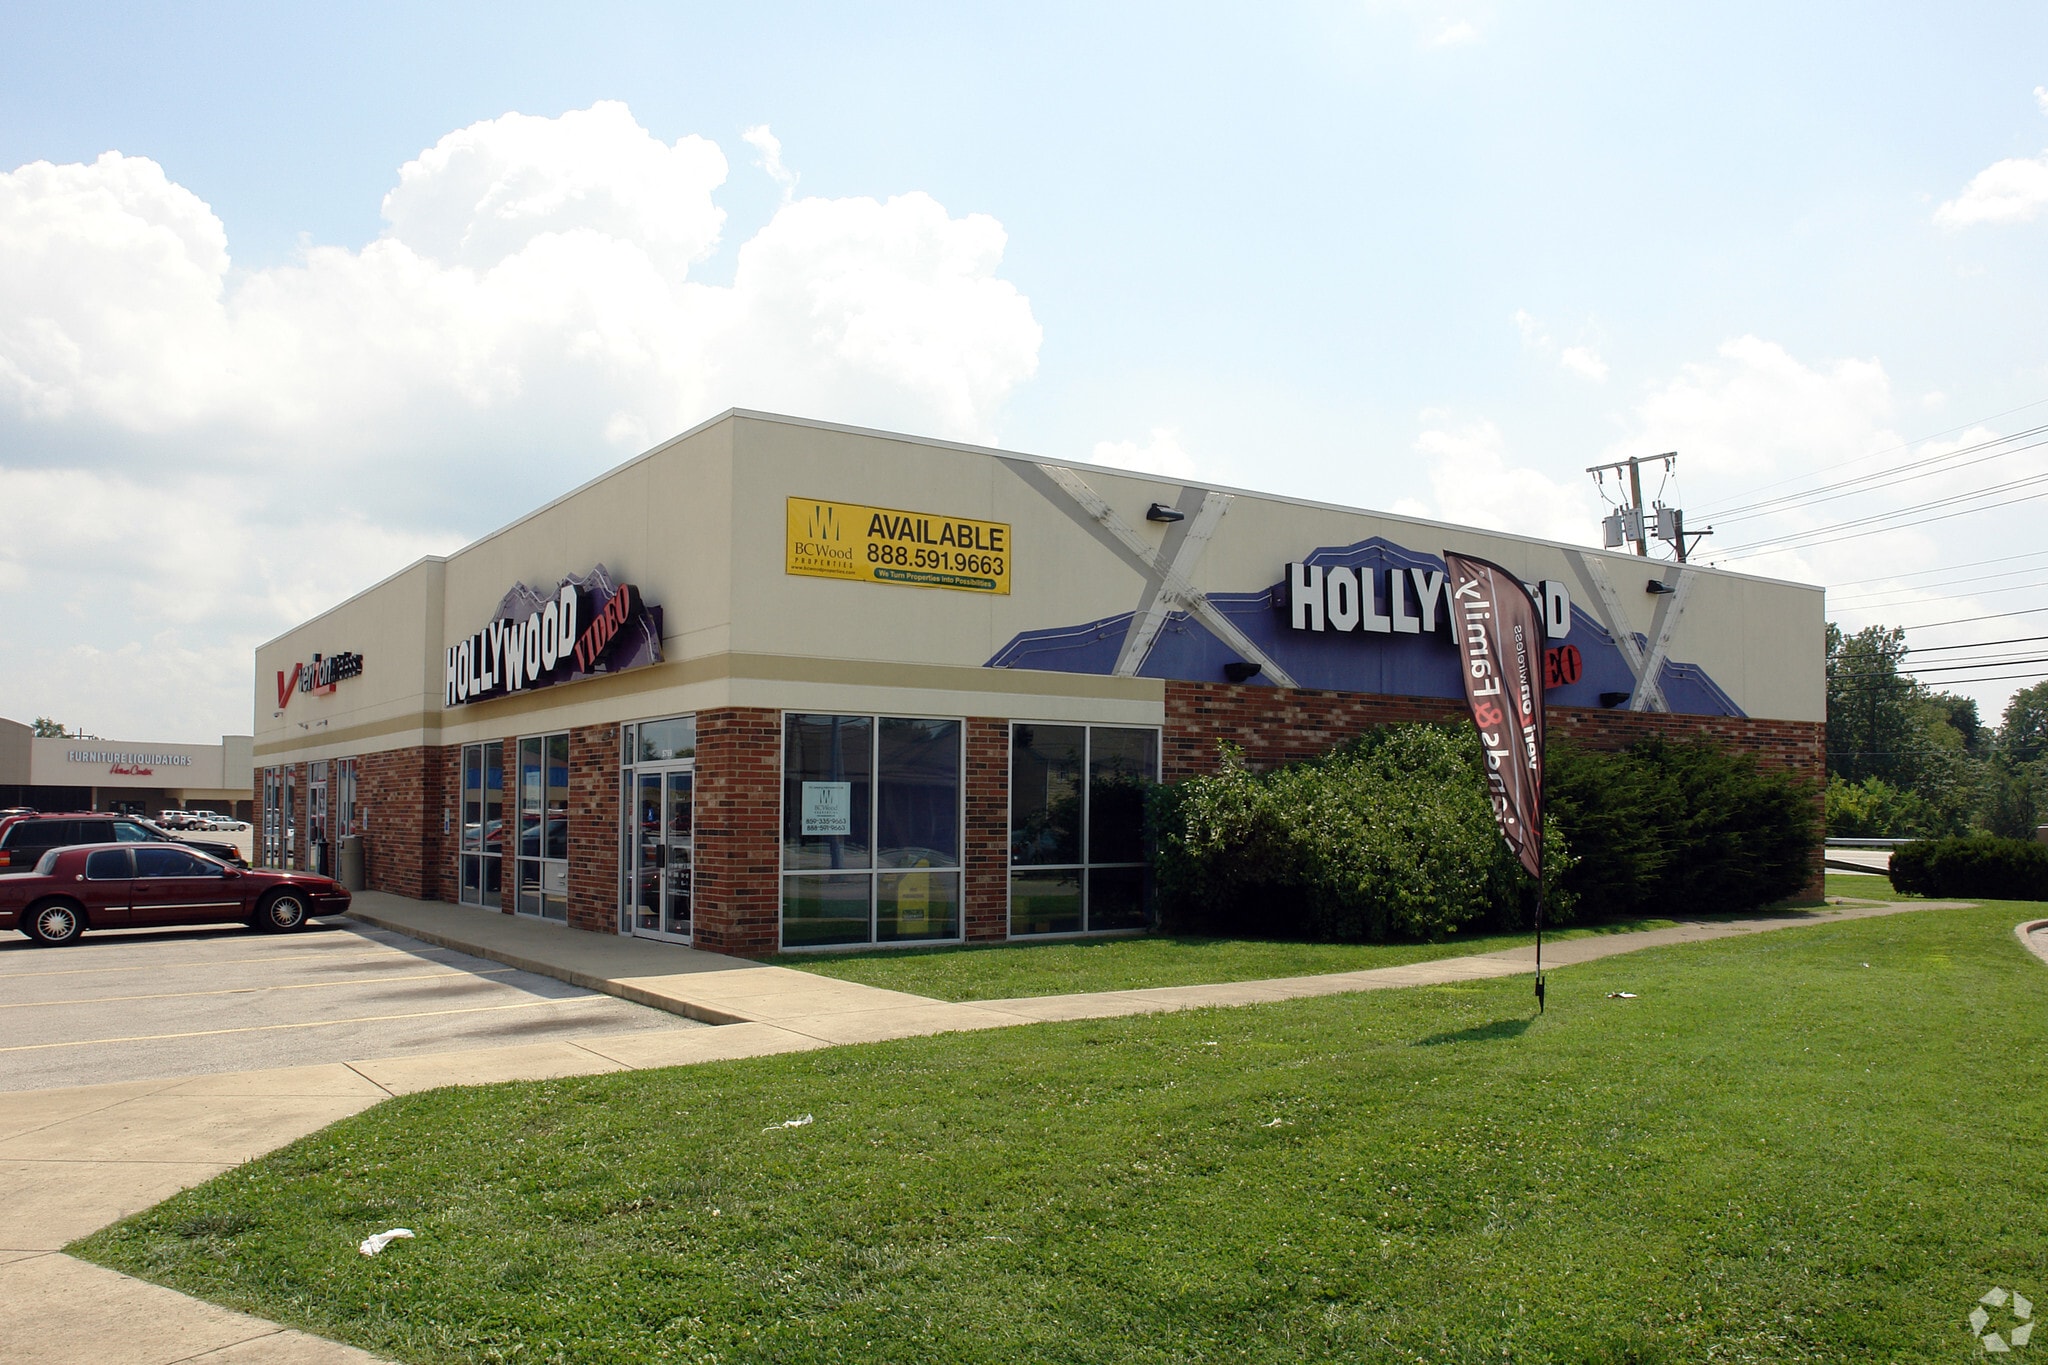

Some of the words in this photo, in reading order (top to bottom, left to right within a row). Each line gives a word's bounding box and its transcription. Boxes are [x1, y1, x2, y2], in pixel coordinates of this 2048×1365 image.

[867, 513, 1004, 552] AVAILABLE
[795, 557, 853, 569] PROPERTIES
[867, 543, 1004, 576] 888.591.9663
[891, 571, 905, 579] Turn
[907, 572, 940, 582] Properties
[955, 578, 992, 588] Possibilities
[445, 583, 581, 706] HOLLYWOOD
[574, 582, 635, 675] VIDEO
[68, 750, 127, 764] FURNITURE
[127, 753, 192, 766] LIQUIDATORS
